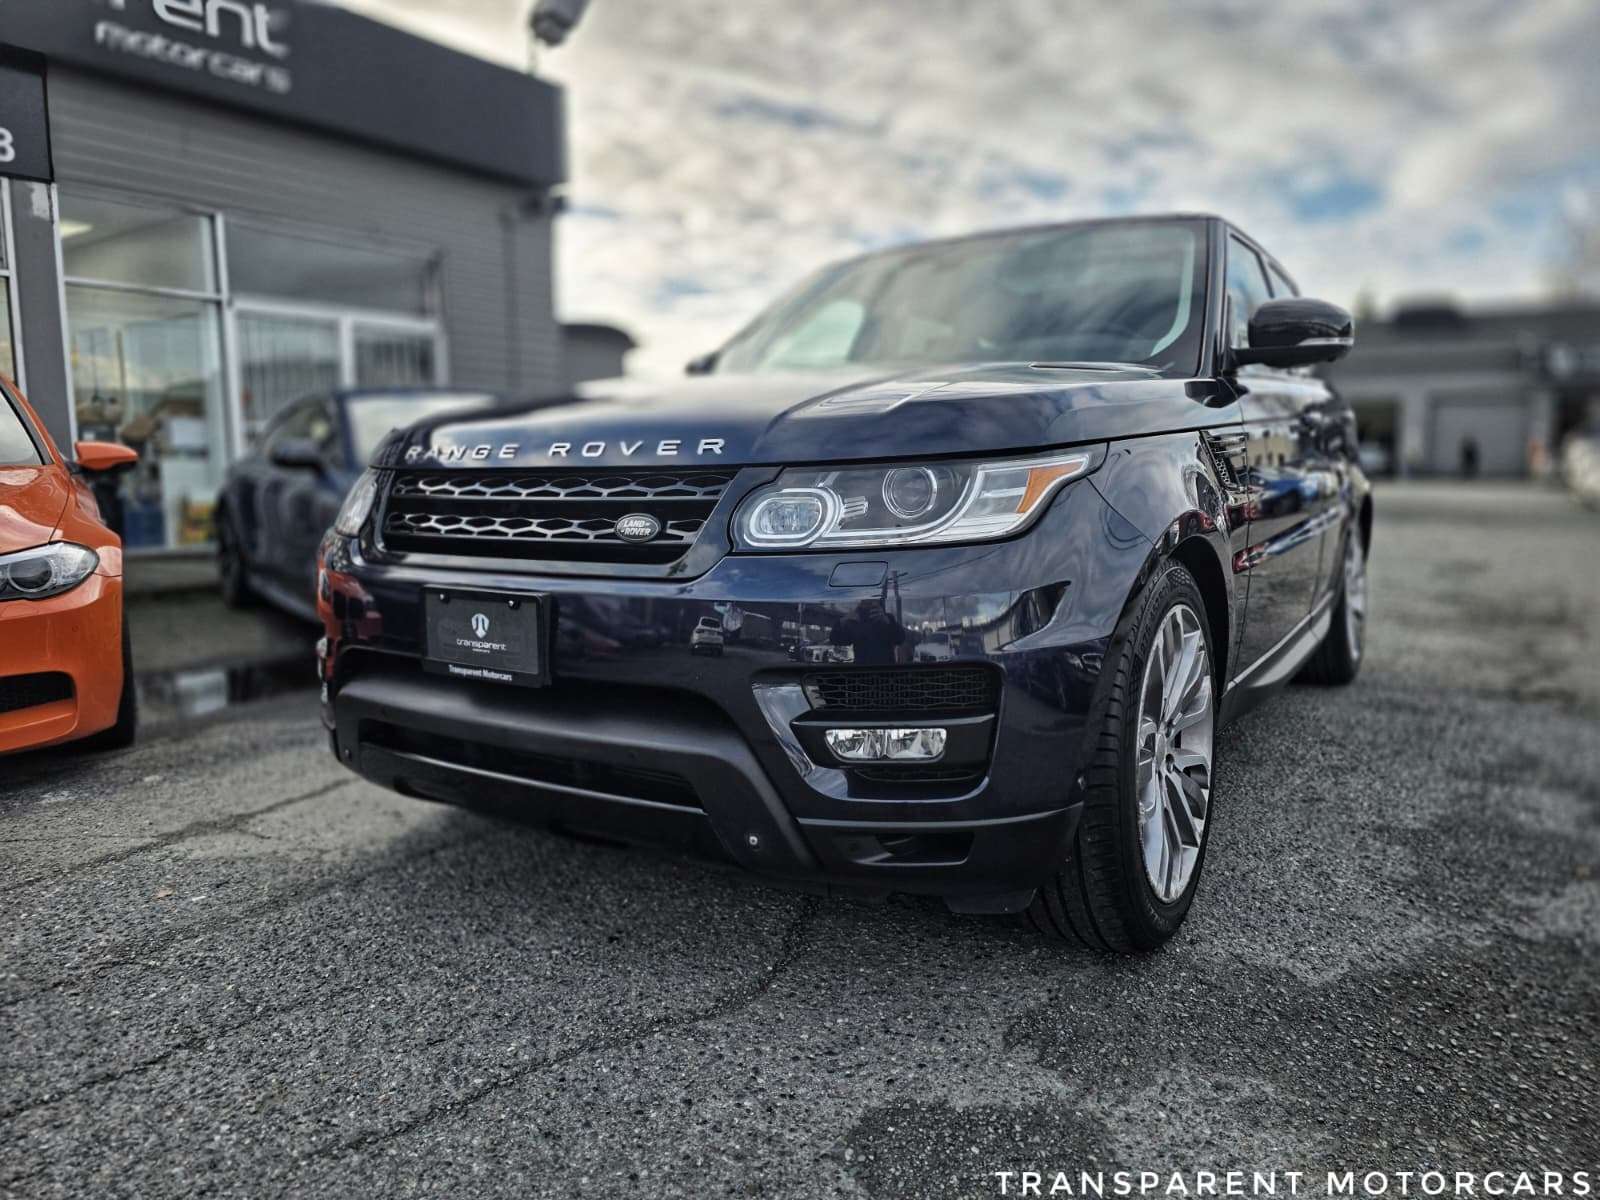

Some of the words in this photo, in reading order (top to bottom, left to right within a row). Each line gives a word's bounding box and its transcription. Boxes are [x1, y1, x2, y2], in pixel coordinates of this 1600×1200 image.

[109, 0, 288, 57] ent
[94, 21, 292, 94] motorcars
[404, 444, 520, 464] RANGE
[548, 438, 726, 458] ROVER
[456, 638, 507, 651] transparent
[448, 664, 482, 678] Transparent
[482, 669, 512, 681] Motorcars
